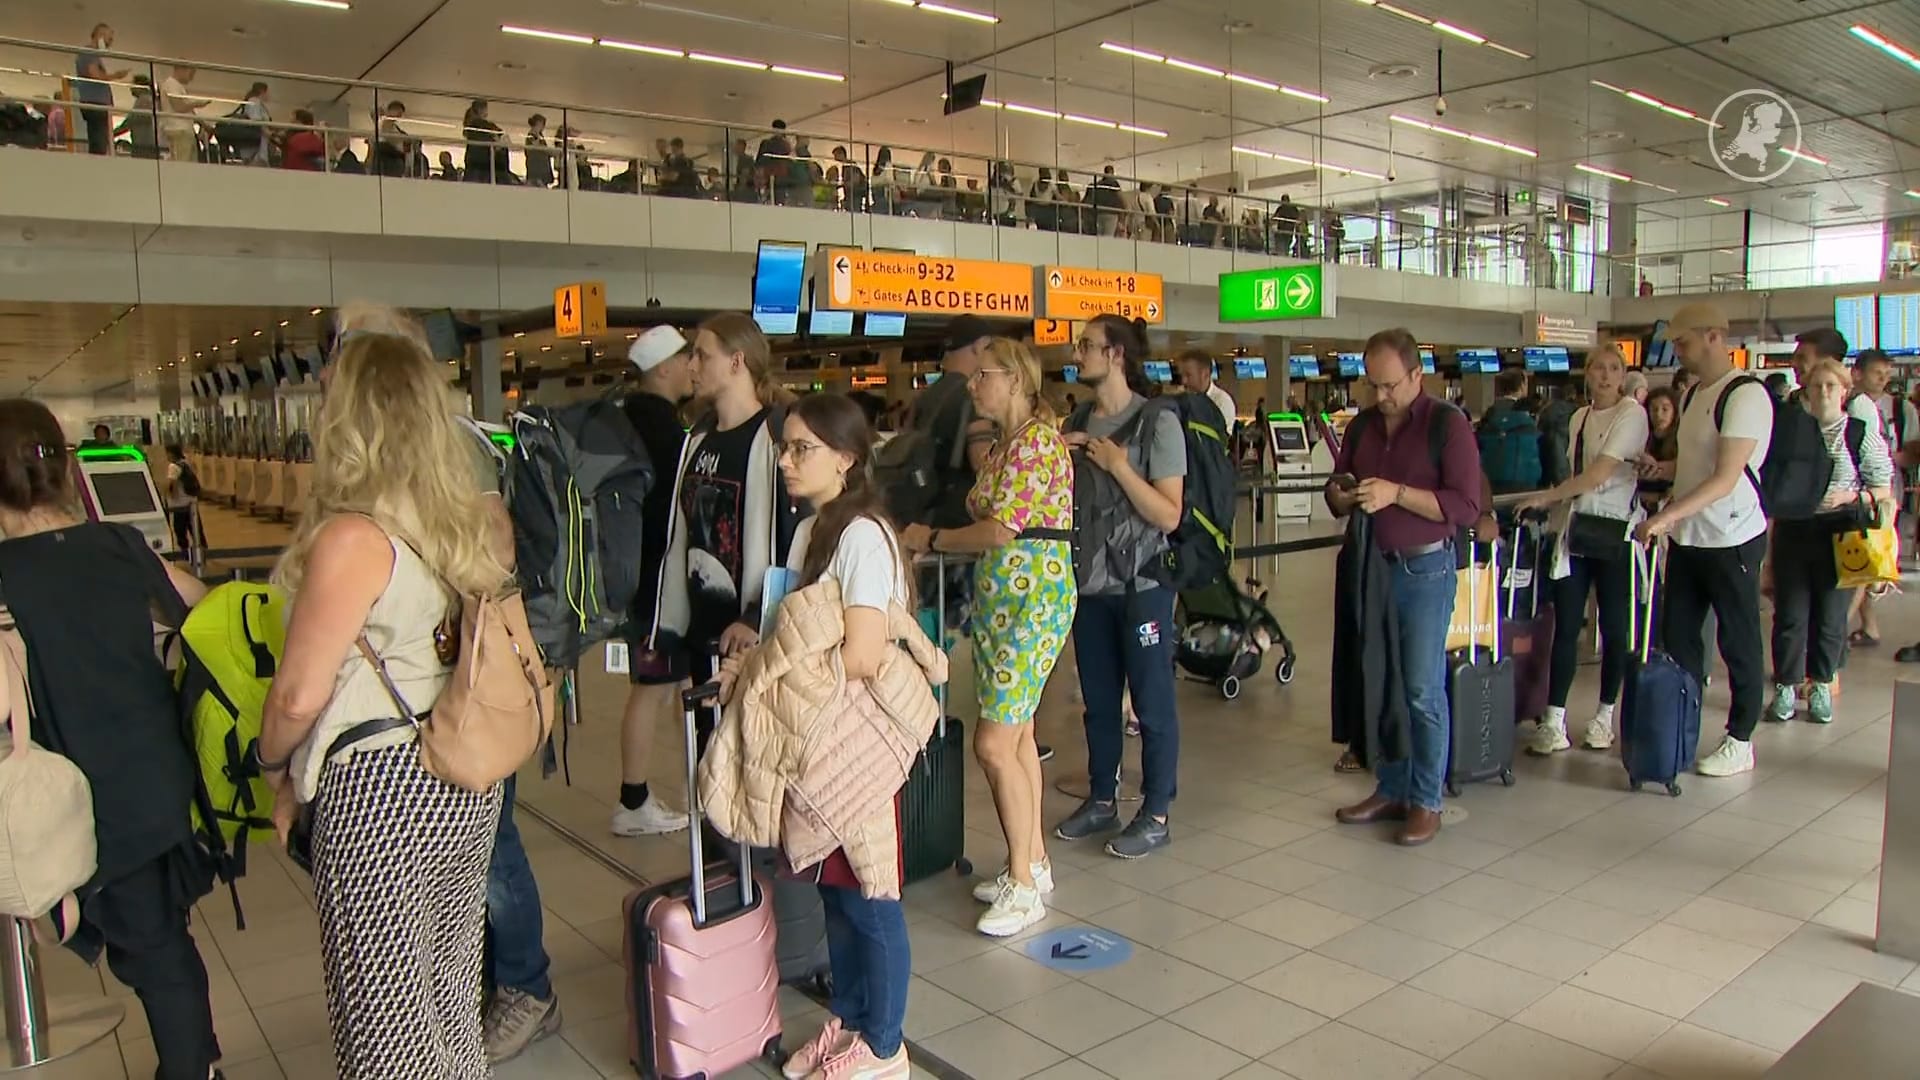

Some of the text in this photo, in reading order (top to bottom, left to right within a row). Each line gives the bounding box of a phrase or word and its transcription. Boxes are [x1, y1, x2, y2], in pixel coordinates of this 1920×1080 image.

[873, 261, 955, 282] Check-in 9-32
[1079, 275, 1136, 293] Check-in 1-8
[873, 288, 903, 303] Gates
[563, 289, 572, 322] 4
[1079, 300, 1131, 317] Check-in 1a
